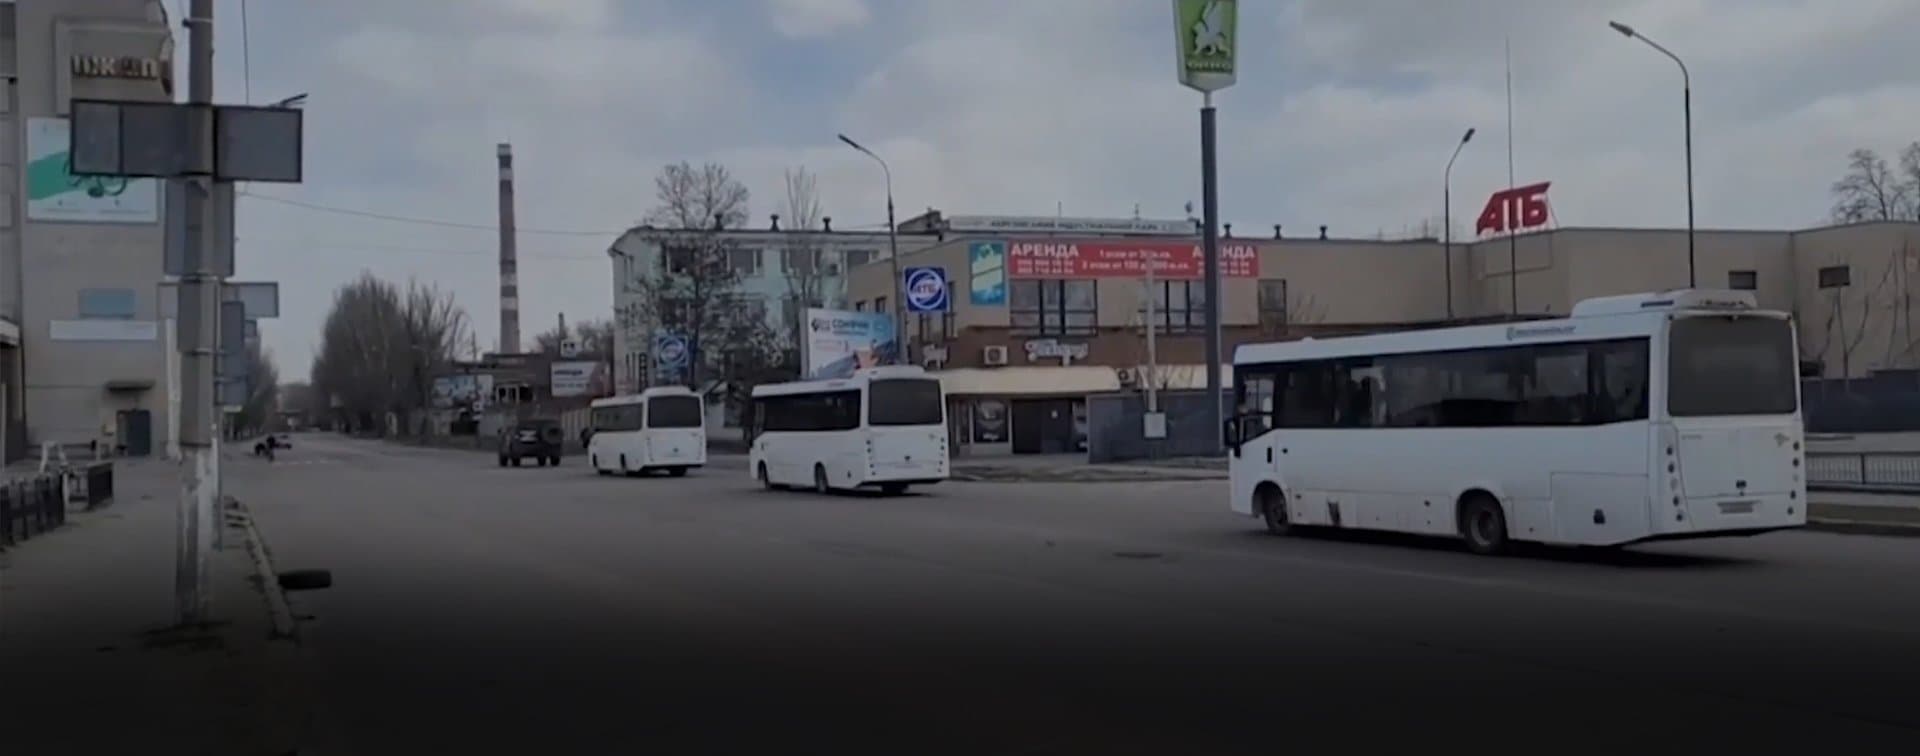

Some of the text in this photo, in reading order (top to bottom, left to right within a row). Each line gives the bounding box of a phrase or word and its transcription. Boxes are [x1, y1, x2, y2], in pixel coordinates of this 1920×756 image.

[1476, 182, 1551, 235] АТБ
[1010, 243, 1079, 258] АРЕНДА
[1192, 245, 1255, 259] АНДА
